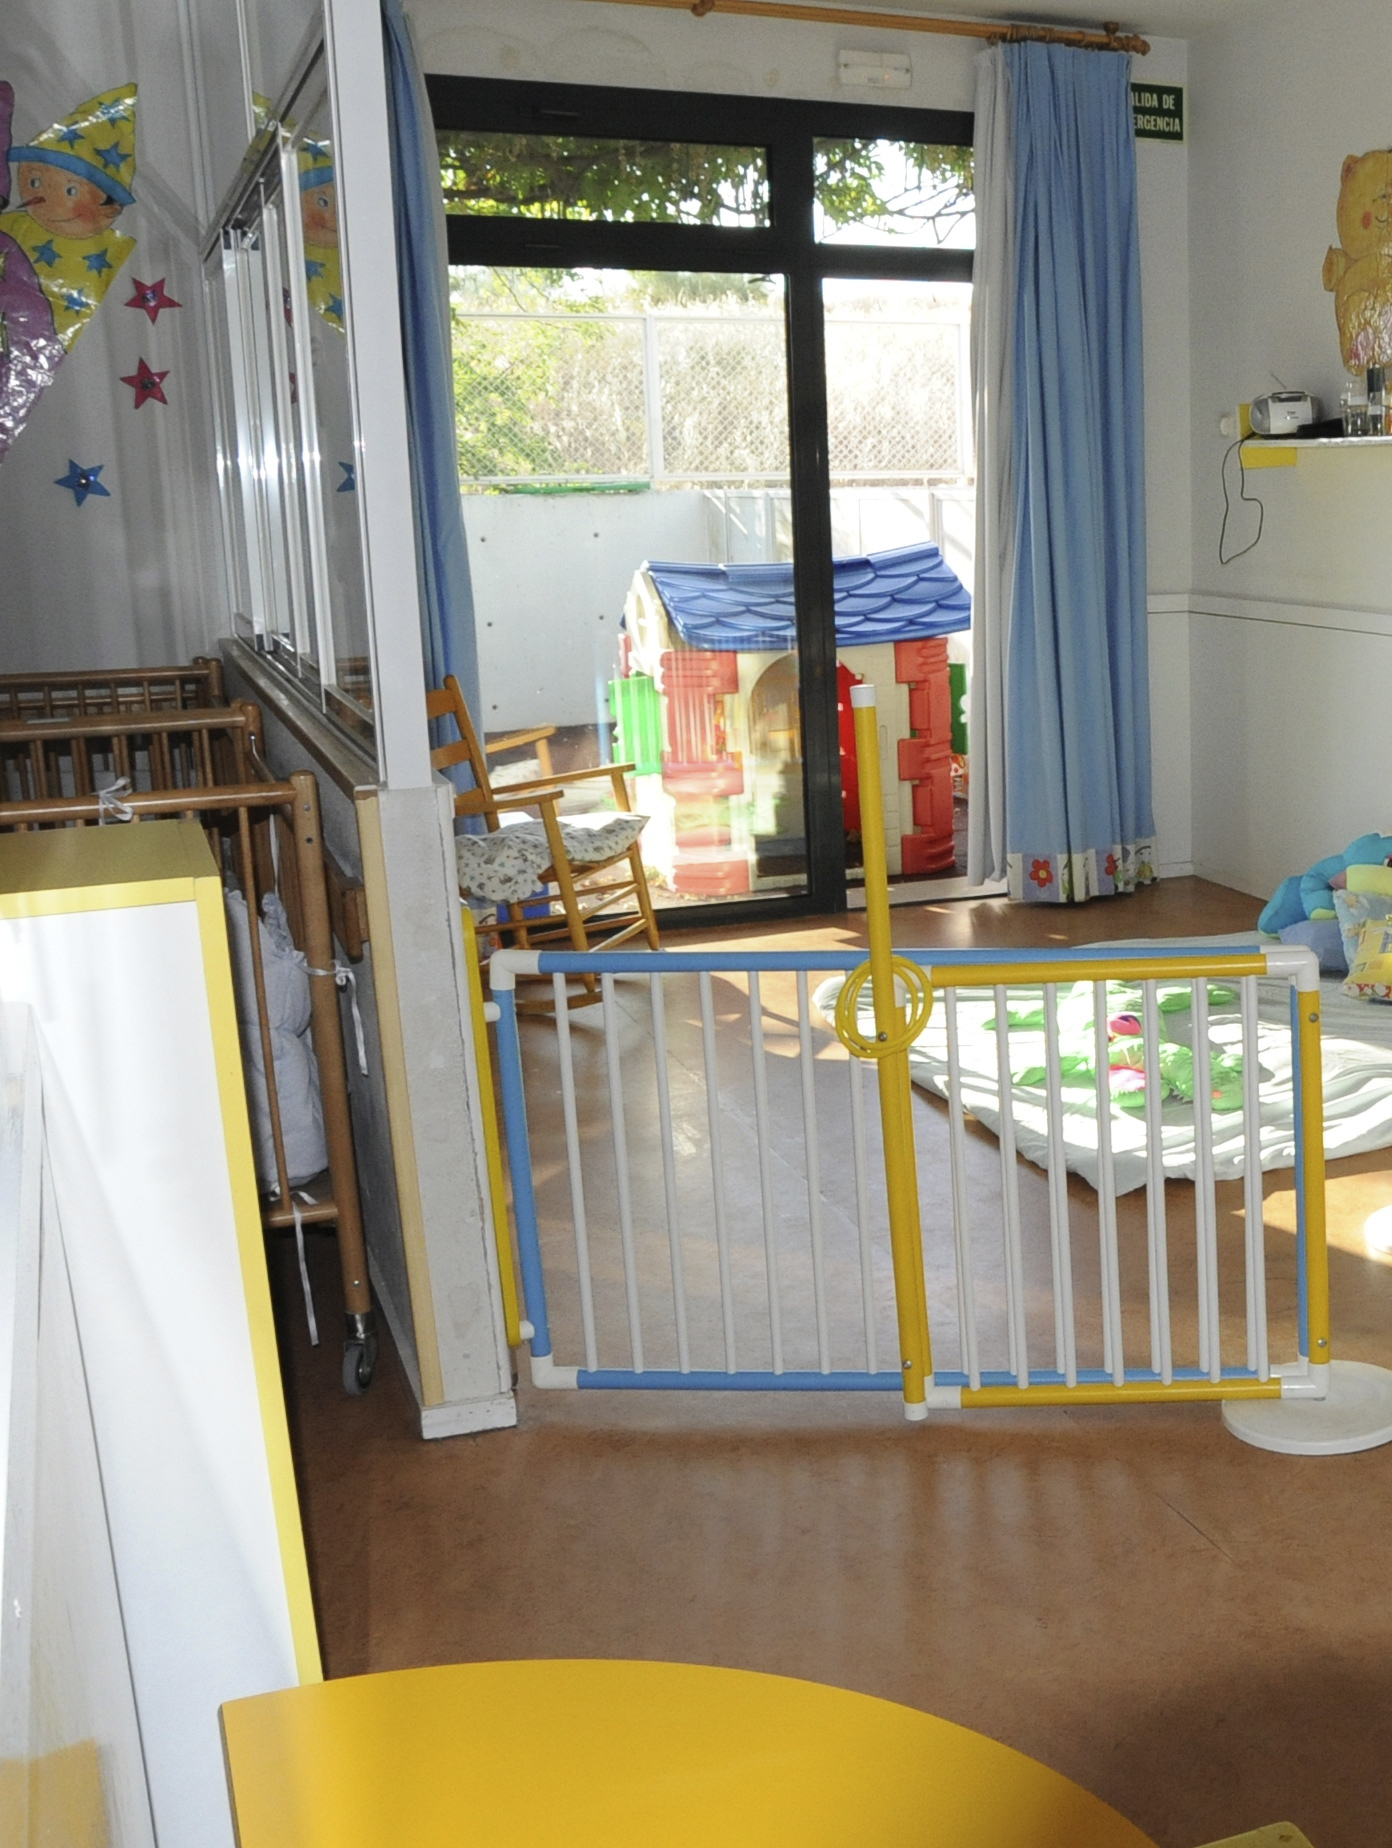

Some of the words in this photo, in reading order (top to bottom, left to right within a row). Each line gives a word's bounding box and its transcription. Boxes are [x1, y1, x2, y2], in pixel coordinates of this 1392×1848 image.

[1131, 91, 1158, 108] ALIDA
[1162, 94, 1176, 110] DE
[1133, 114, 1181, 132] ERGENCIA
